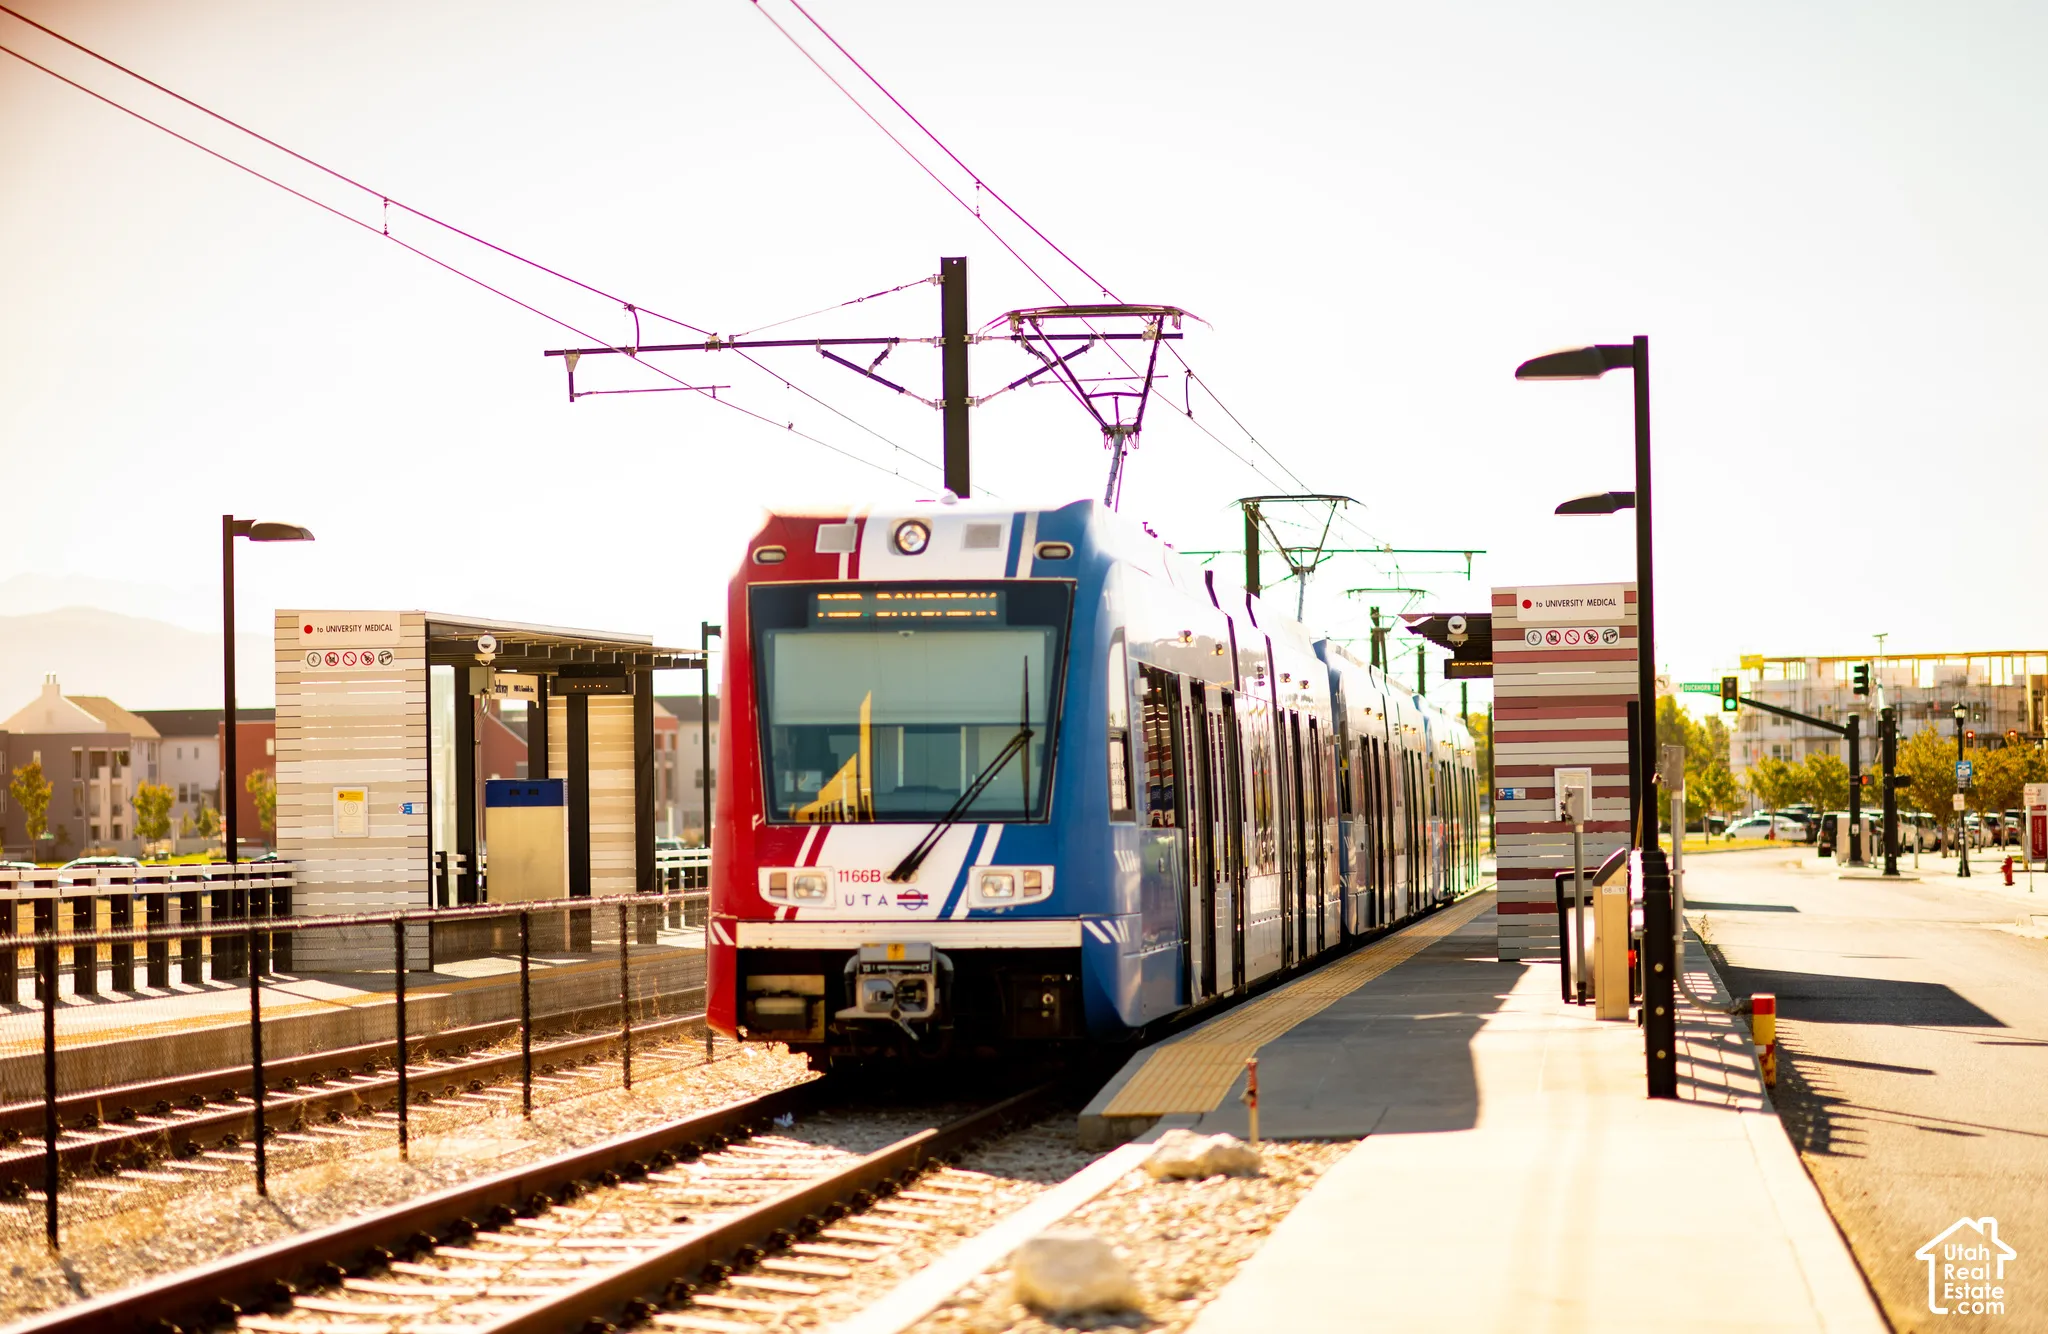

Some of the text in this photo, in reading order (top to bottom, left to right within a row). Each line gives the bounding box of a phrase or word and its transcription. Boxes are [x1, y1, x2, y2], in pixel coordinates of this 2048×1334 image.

[1545, 599, 1584, 608] UNIVERSITY
[1586, 598, 1617, 607] MEDICAL
[326, 624, 362, 633] UNIVERSITY
[365, 623, 393, 632] MEDICAL
[838, 869, 881, 883] 1166B
[845, 893, 888, 907] UTA
